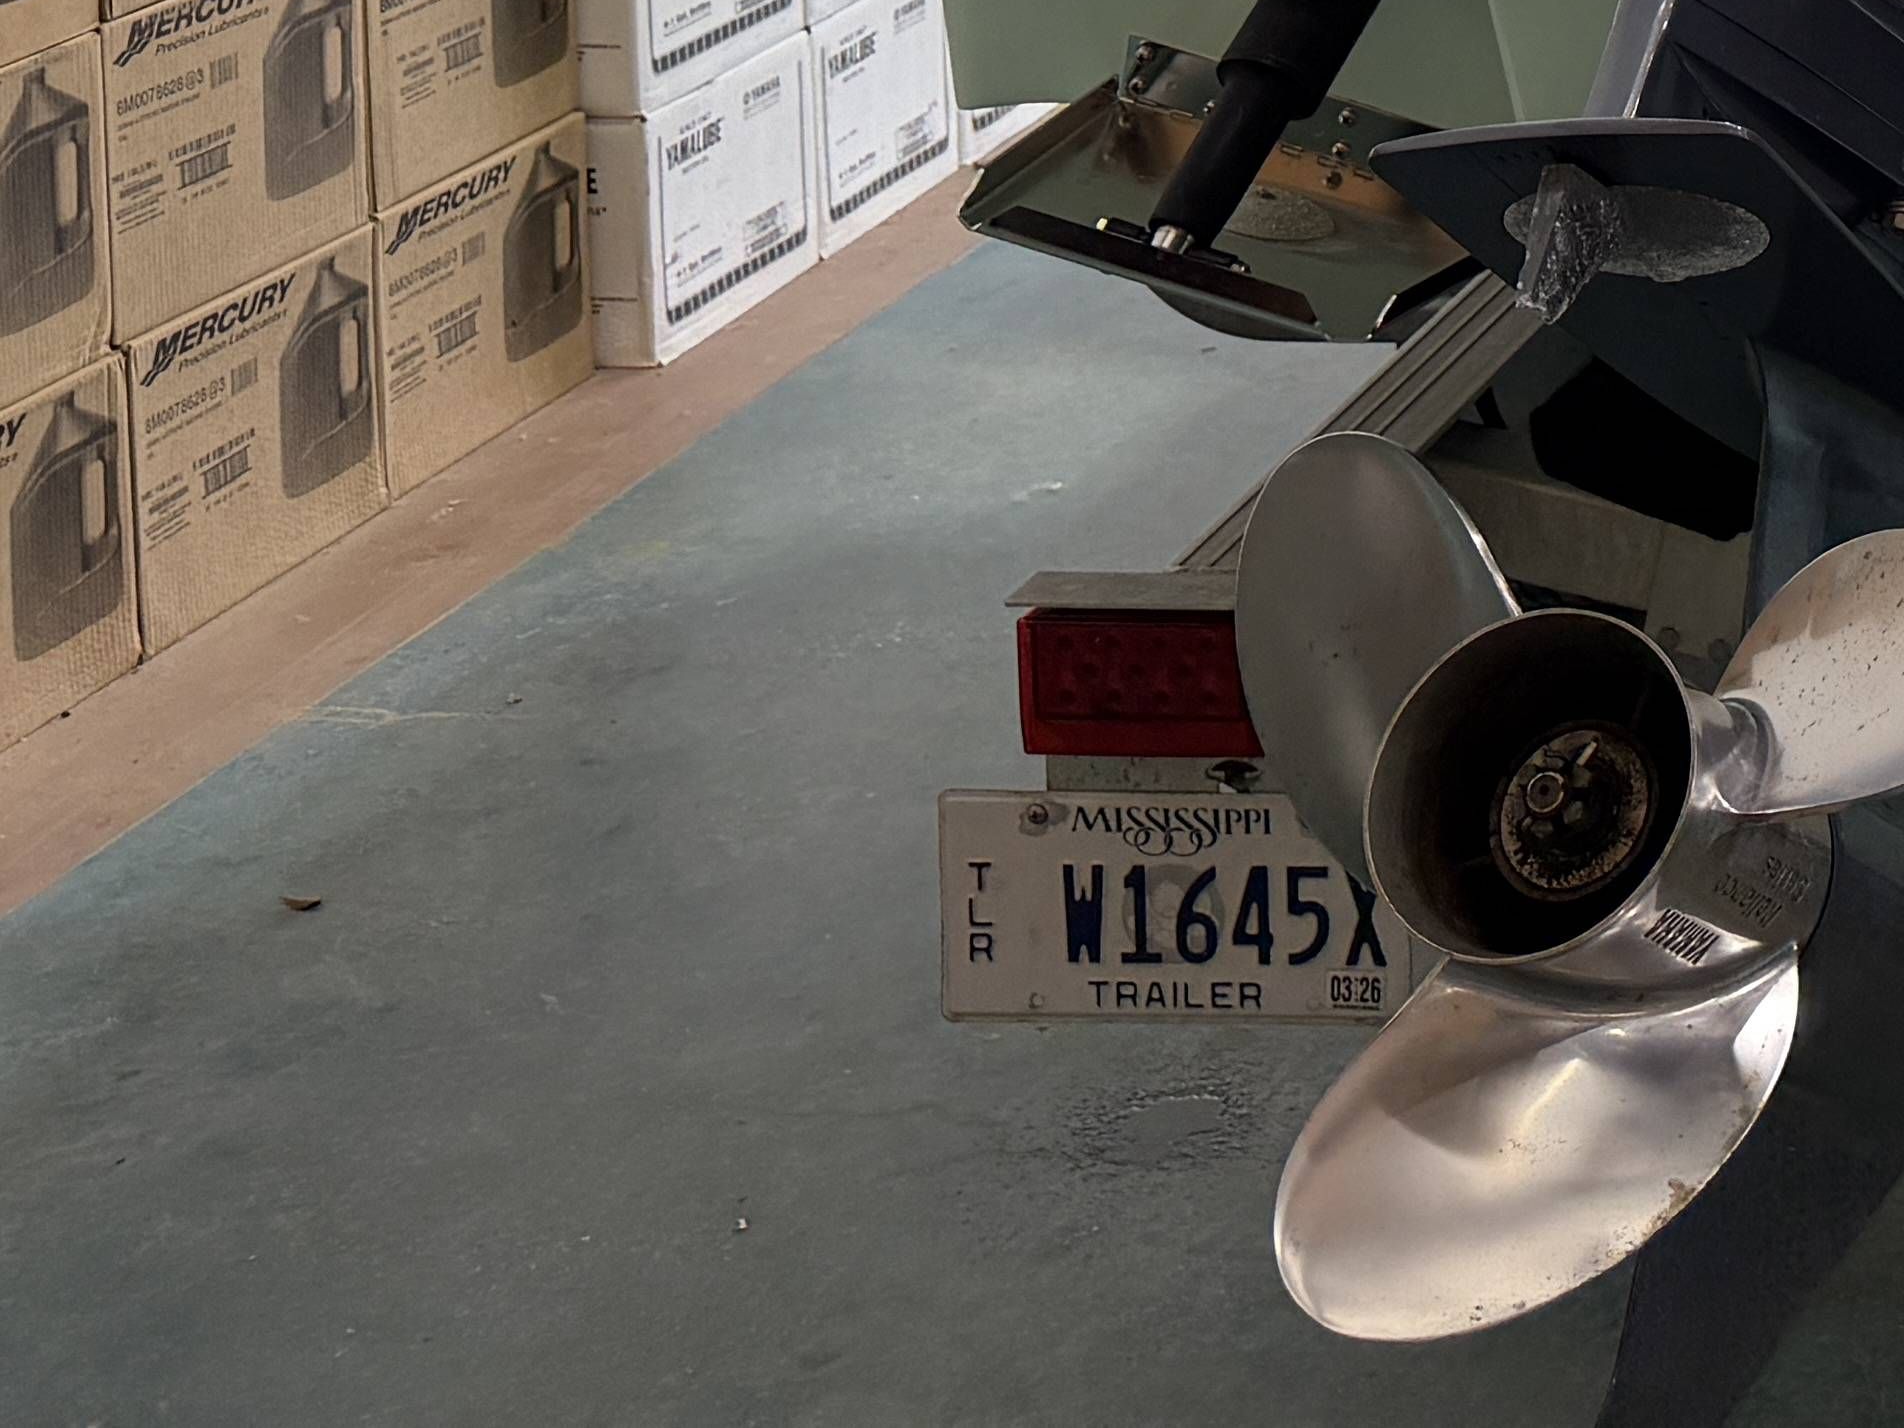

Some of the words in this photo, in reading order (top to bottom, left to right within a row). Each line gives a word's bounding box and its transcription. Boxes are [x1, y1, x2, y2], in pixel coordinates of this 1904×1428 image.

[155, 30, 206, 56] Precision
[385, 155, 517, 256] MERCURY
[140, 272, 297, 387] MERCURY
[1071, 806, 1272, 857] MISSISSIPPI
[968, 862, 993, 963] TLR
[1062, 863, 1388, 968] W1645X
[1643, 908, 1721, 966] YAMAHA
[1088, 981, 1263, 1010] TRAILER
